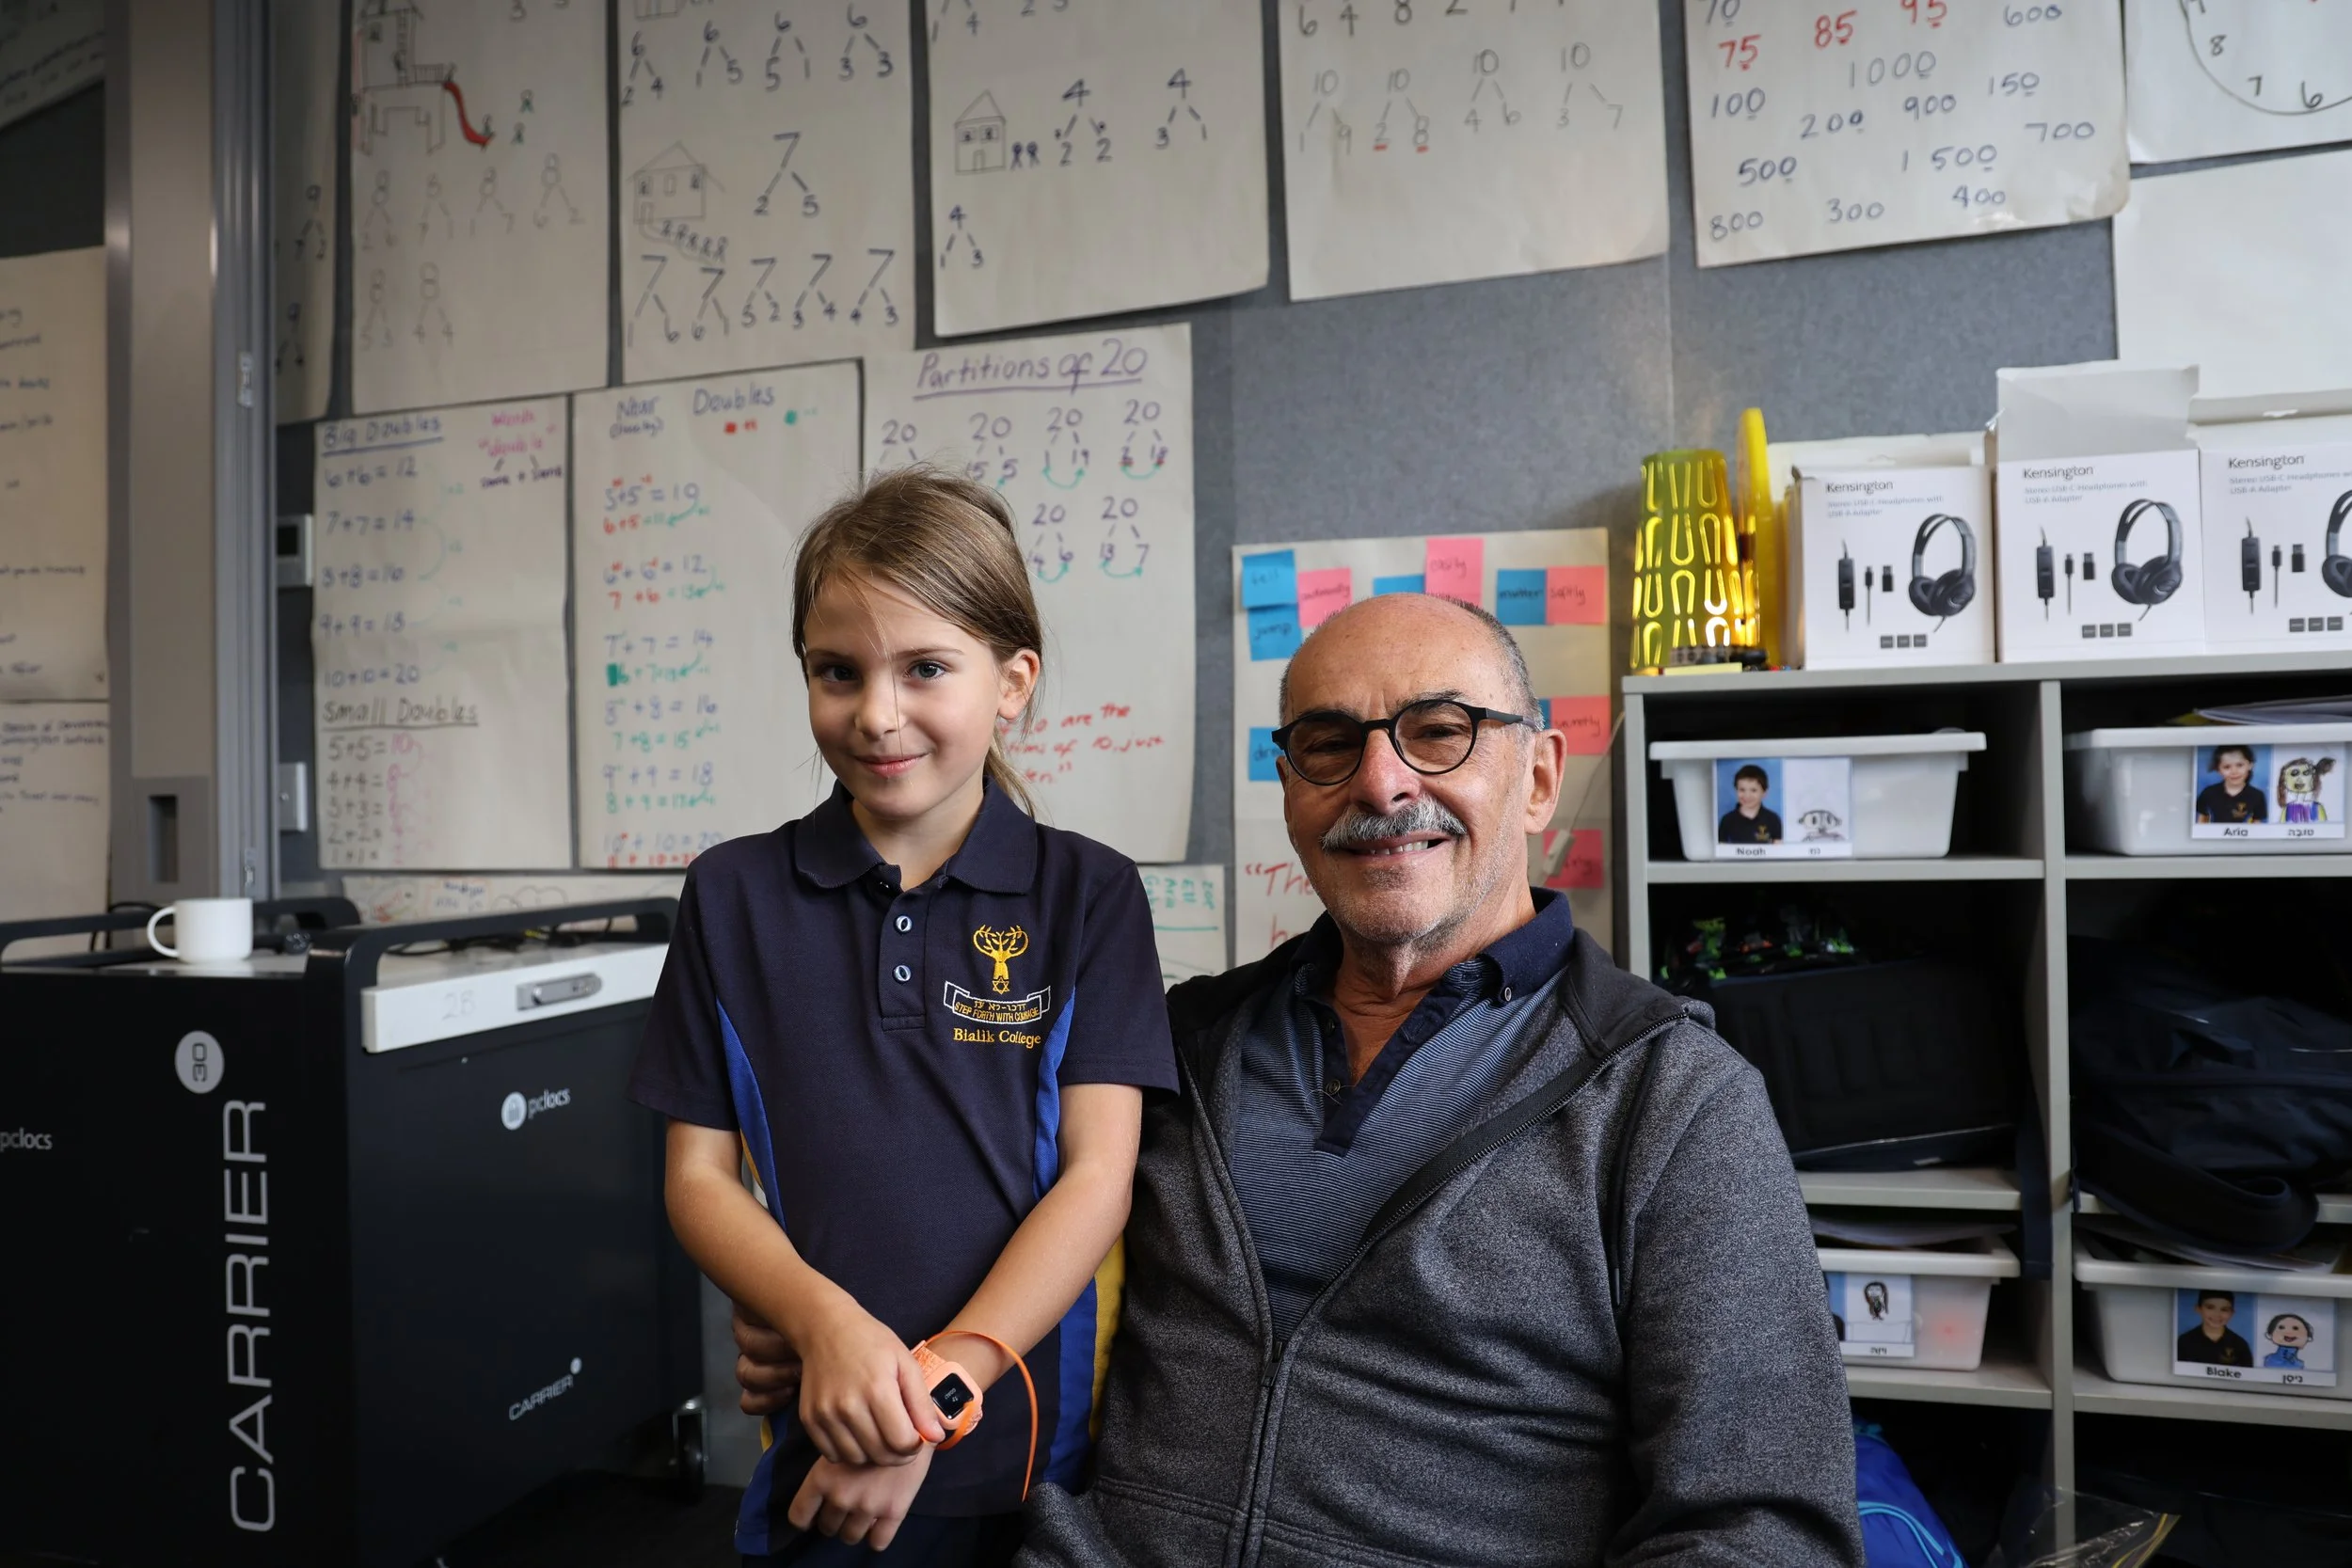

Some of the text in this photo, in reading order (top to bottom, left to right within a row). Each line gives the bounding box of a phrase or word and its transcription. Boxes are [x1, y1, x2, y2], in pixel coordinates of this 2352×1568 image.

[774, 8, 793, 33] 6
[848, 1, 869, 30] 6
[1813, 8, 1858, 50] 85
[2001, 4, 2062, 28] 600
[631, 29, 646, 58] 6
[705, 19, 721, 44] 6
[2208, 33, 2228, 58] 8
[1472, 48, 1501, 77] 10
[1560, 40, 1592, 73] 10
[1717, 34, 1762, 71] 75
[1313, 68, 1340, 97] 10
[1387, 66, 1410, 93] 10
[1848, 49, 1937, 89] 1000
[1060, 78, 1092, 109] 4
[1166, 67, 1193, 101] 4
[1986, 71, 2040, 97] 150
[2245, 73, 2265, 98] 7
[2298, 79, 2325, 110] 6
[1710, 87, 2095, 143] 100 200 900 700
[1737, 155, 1797, 187] 500
[948, 203, 968, 231] 4
[1708, 184, 2006, 244] 800 300 400
[916, 337, 1149, 396] Partitions of 20
[1046, 406, 1083, 433] 20
[1123, 398, 1162, 426] 20
[881, 419, 917, 447] 20
[968, 411, 1012, 442] 20
[2023, 465, 2094, 481] Kensington
[2228, 453, 2305, 470] Kensington
[1825, 480, 1894, 495] Kensington
[1032, 502, 1066, 526] 20
[1101, 495, 1139, 520] 20
[2223, 827, 2249, 837] Aria
[1736, 847, 1766, 856] Noah
[954, 1001, 1040, 1022] STEP FORTH WITH COURAGE
[953, 1027, 1041, 1049] Bialik College
[526, 1087, 571, 1118] pclocs
[0, 1127, 53, 1149] pclocs
[222, 1099, 276, 1531] CARRIER
[2206, 1367, 2242, 1379] Blake
[508, 1374, 573, 1421] CARRIER
